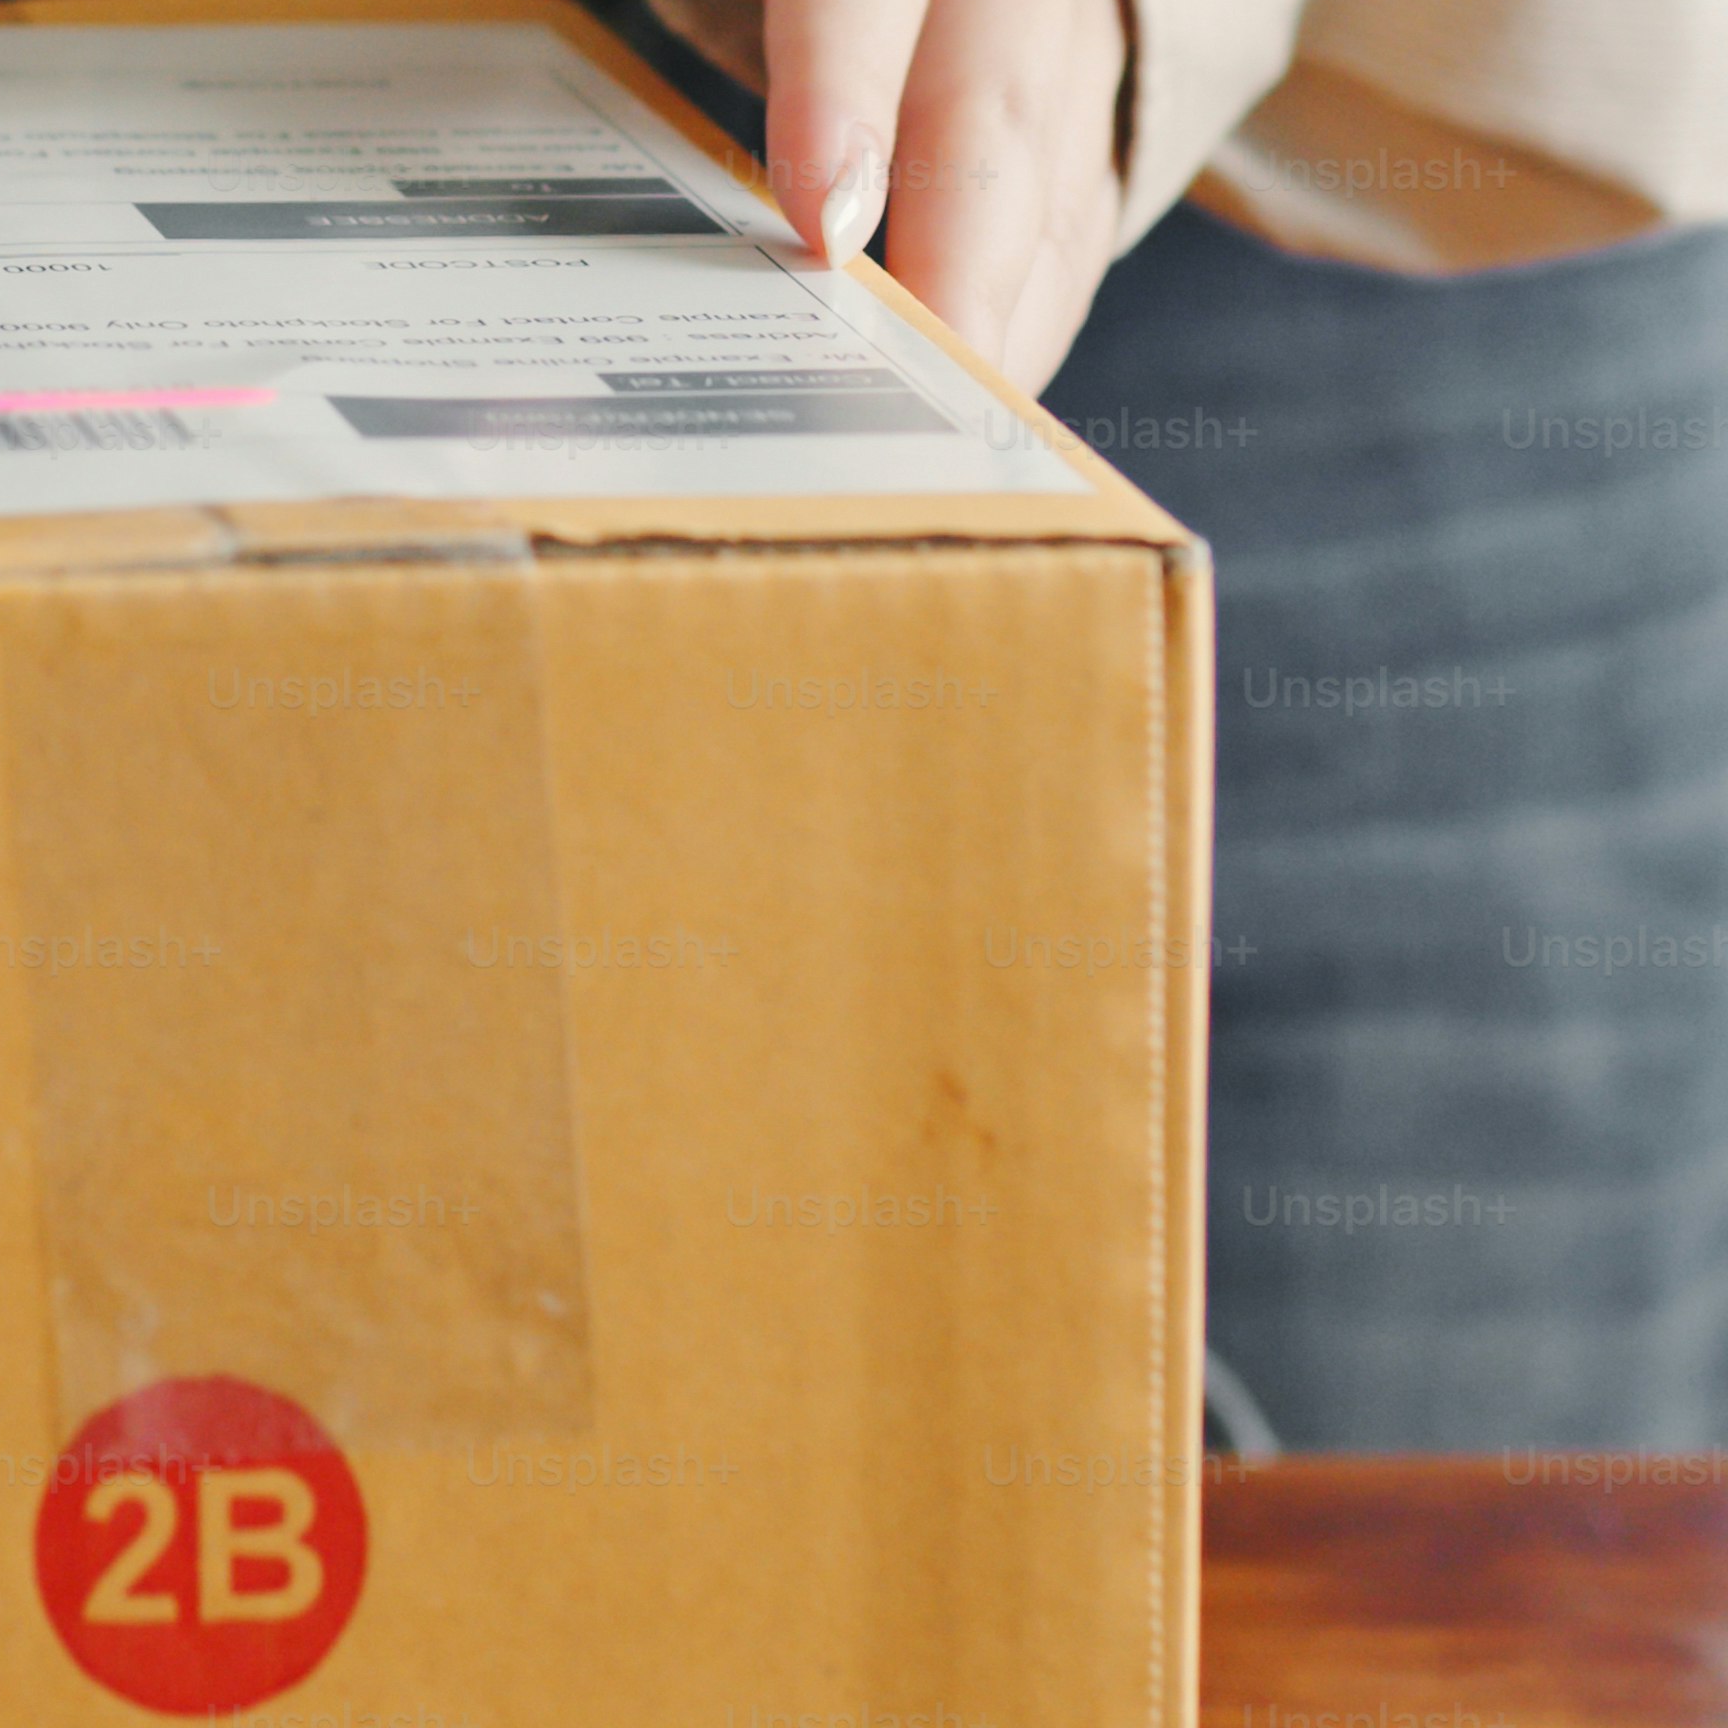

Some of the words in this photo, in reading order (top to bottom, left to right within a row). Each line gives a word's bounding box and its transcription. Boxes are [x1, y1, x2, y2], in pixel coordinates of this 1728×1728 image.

[304, 214, 551, 227] ADDRESSEE
[2, 263, 113, 274] 10000
[362, 258, 592, 271] POSTCODE
[424, 317, 489, 328] For
[499, 314, 645, 325] Contact
[658, 312, 823, 323] Example
[106, 319, 189, 331] Only
[202, 318, 411, 329] Stockphoto
[402, 335, 566, 347] Example
[687, 332, 838, 342] Address
[172, 339, 230, 350] For
[245, 338, 388, 349] Contact
[492, 356, 614, 368] Online
[629, 353, 793, 365] Example
[728, 374, 872, 387] Contact
[82, 1467, 324, 1625] 2B
